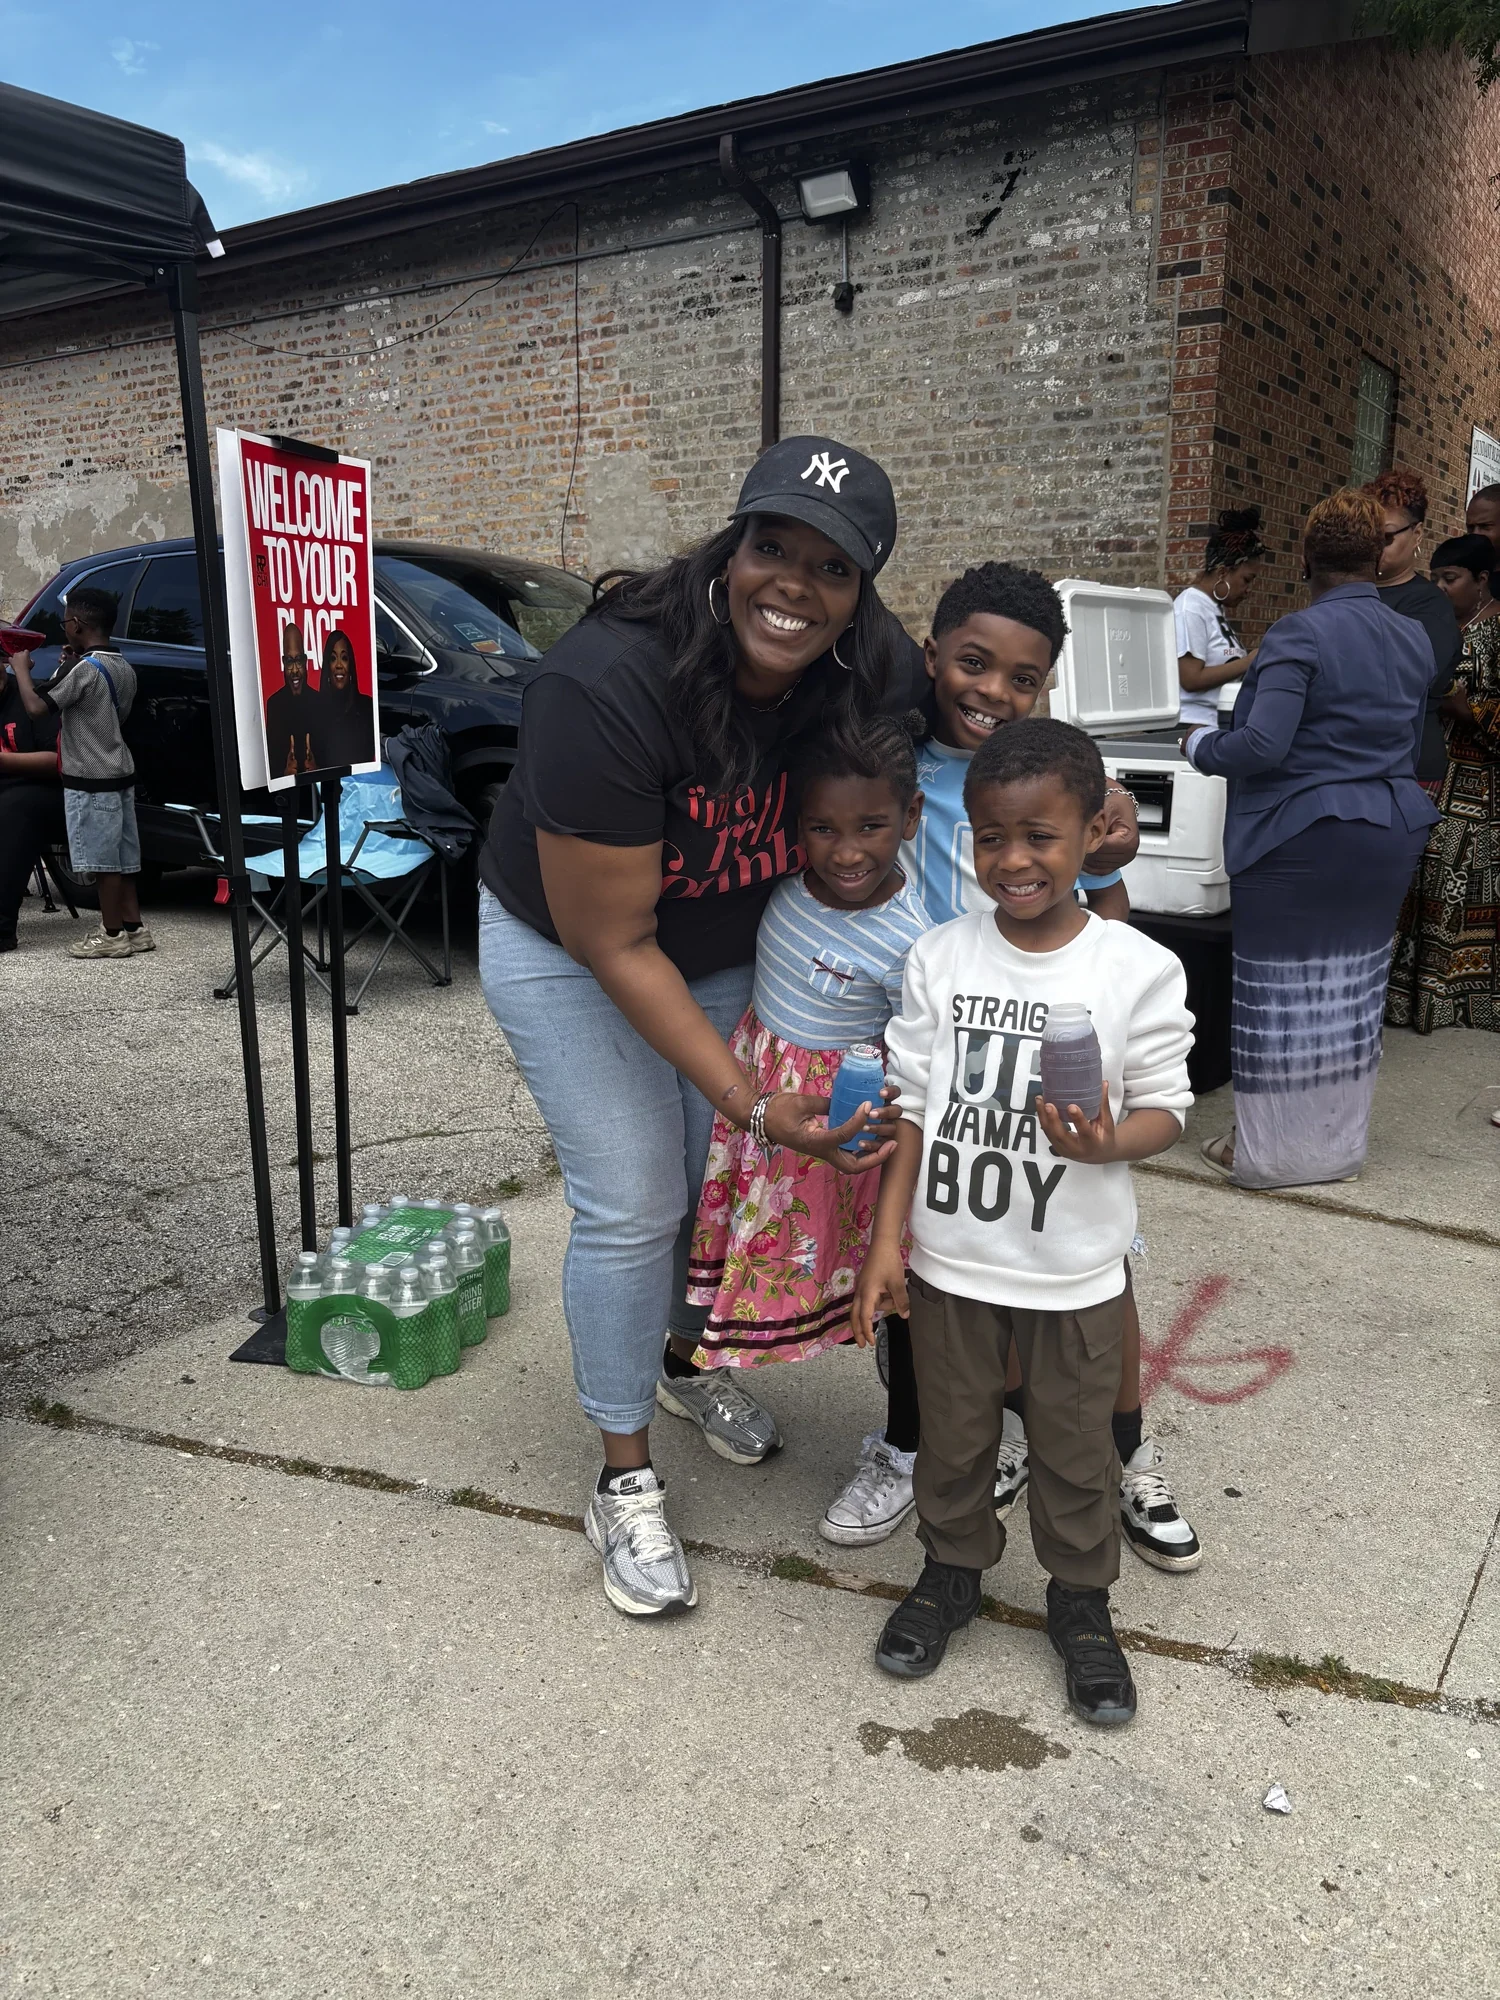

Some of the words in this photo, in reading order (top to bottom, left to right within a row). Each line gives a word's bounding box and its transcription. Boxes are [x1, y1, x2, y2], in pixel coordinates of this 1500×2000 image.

[245, 457, 363, 543] WELCOME
[800, 451, 850, 493] NY
[262, 535, 293, 604] TO
[293, 538, 358, 607] YOUR
[952, 993, 1050, 1033] STRAIG
[926, 1139, 1067, 1233] BOY
[619, 1475, 639, 1489] NIKE
